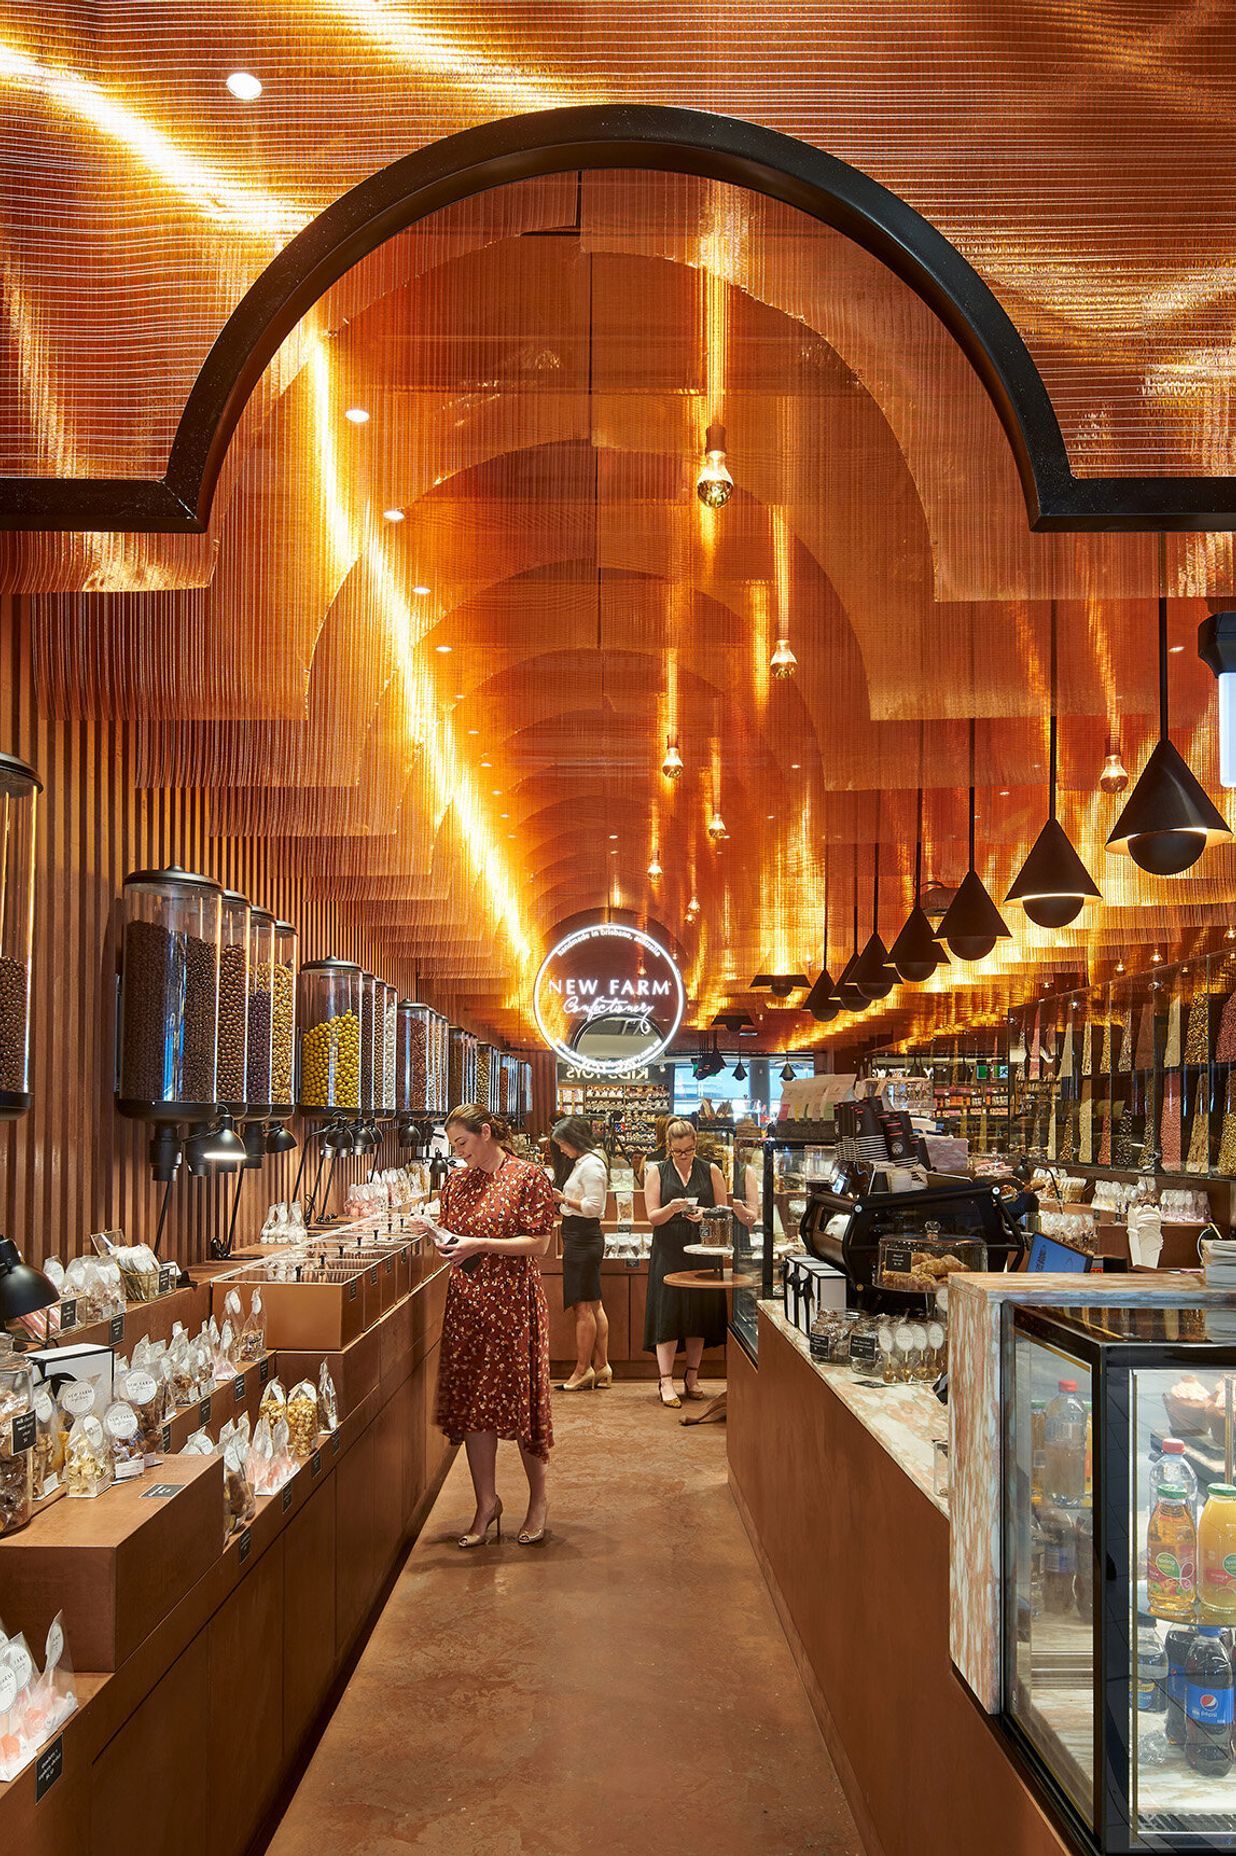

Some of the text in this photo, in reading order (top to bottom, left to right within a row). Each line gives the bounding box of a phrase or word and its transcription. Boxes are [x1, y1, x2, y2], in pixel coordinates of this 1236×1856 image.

[548, 979, 670, 996] NEW FARM
[563, 995, 655, 1035] Confectionery
